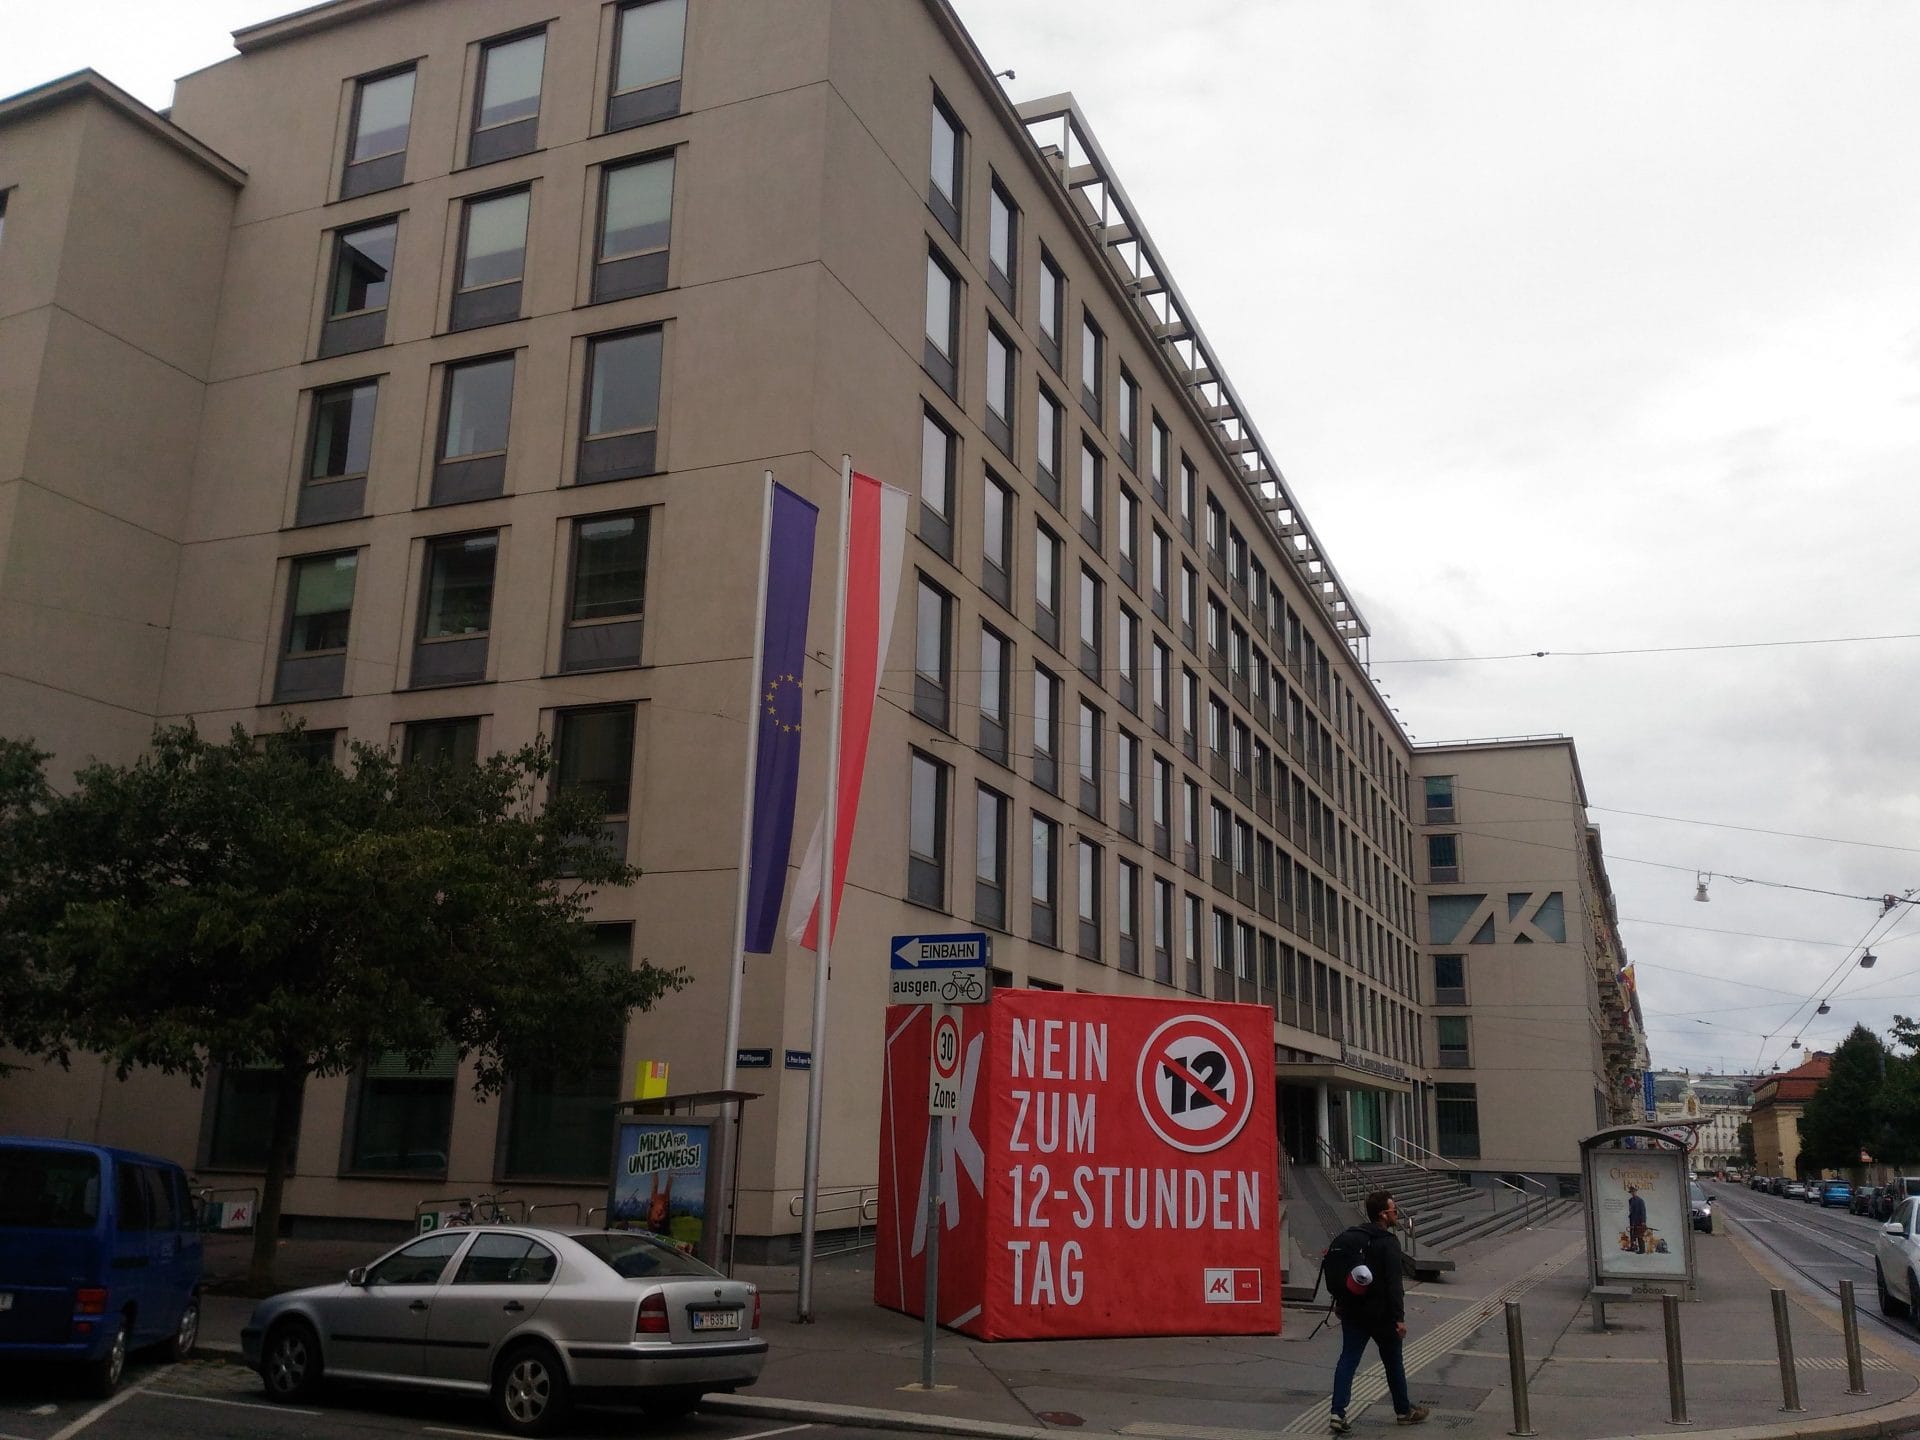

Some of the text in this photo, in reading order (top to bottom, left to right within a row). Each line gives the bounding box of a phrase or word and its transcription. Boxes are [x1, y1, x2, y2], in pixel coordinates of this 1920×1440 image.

[1450, 892, 1557, 944] AK
[921, 942, 974, 959] EINBAHN
[893, 980, 941, 997] ausgen.
[940, 1032, 954, 1062] 30
[1011, 1018, 1108, 1082] NEIN
[933, 1082, 957, 1109] Zone
[1162, 1050, 1228, 1115] 12
[1009, 1090, 1096, 1154] ZUM
[628, 1145, 700, 1174] UNTERWEGS!
[1008, 1164, 1260, 1231] 12-STUNDEN
[1007, 1240, 1084, 1306] TAG
[1209, 1278, 1230, 1294] AK
